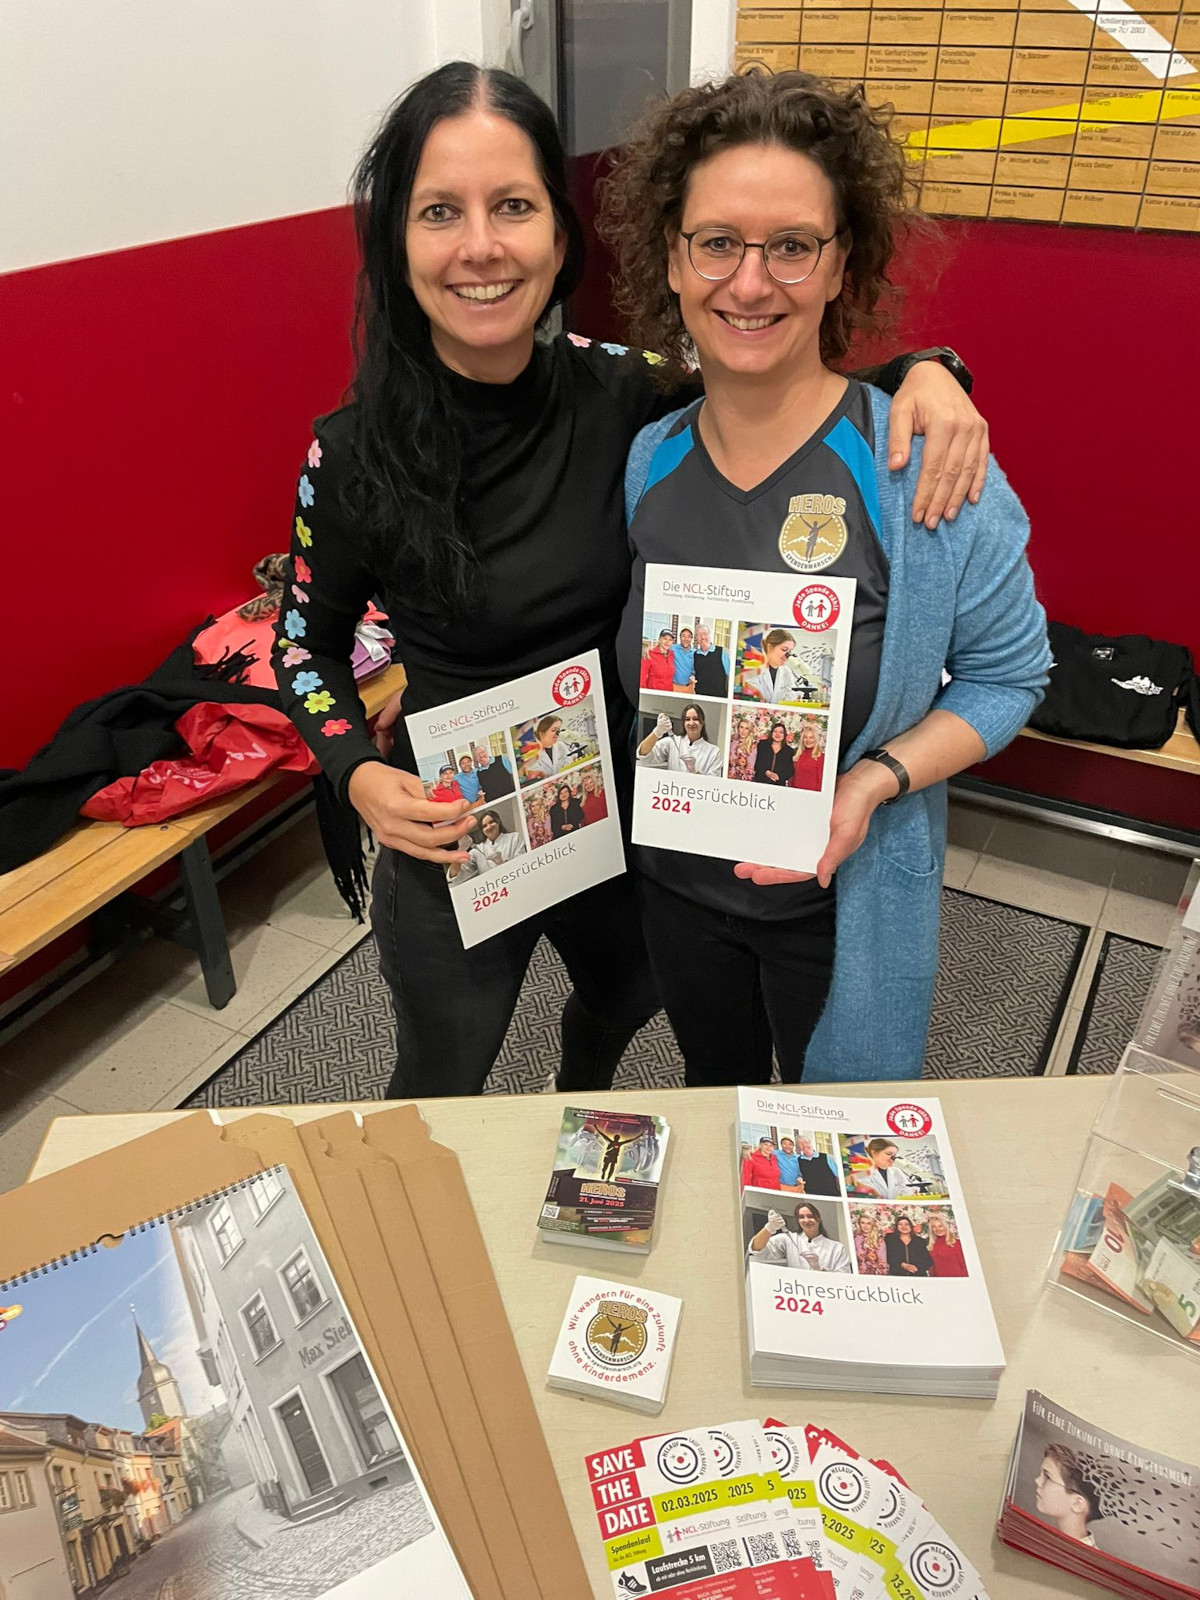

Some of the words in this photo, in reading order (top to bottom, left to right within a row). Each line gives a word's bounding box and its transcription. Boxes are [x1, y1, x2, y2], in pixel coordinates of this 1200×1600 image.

[788, 493, 846, 515] HEROS
[785, 553, 833, 569] SPENDENMARSCH
[663, 580, 680, 592] Die
[683, 582, 751, 600] NCL-Stiftung
[795, 592, 807, 608] Jede
[805, 587, 830, 596] Spende
[829, 592, 839, 611] zählt
[801, 621, 830, 631] DANKE!
[428, 723, 447, 735] Die
[449, 699, 515, 728] NCL-Stiftung
[651, 797, 692, 814] 2024
[652, 781, 776, 811] Jahresrückblick
[470, 842, 577, 900] Jahresrückblick
[472, 887, 509, 913] 2024
[756, 1099, 774, 1110] Die
[777, 1102, 844, 1118] NCL-Stiftung
[580, 1183, 627, 1198] HEROS
[1104, 1227, 1125, 1254] 10
[773, 1278, 924, 1305] Jahresrückblick
[597, 1300, 649, 1324] HEROS
[774, 1295, 824, 1316] 2024
[1178, 1293, 1197, 1318] 5
[568, 1314, 580, 1331] Wir
[577, 1291, 617, 1313] wandern
[619, 1290, 635, 1300] für
[636, 1296, 654, 1313] eine
[652, 1312, 666, 1353] Zukunft
[298, 1343, 325, 1369] Max
[568, 1340, 583, 1364] ohne
[582, 1361, 657, 1382] Kinderdemenz.
[592, 1345, 634, 1363] SPENDENMARSCH
[1032, 1400, 1046, 1420] FÜR
[1047, 1410, 1065, 1431] EINE
[1067, 1421, 1103, 1450] ZUKUNFT
[1104, 1439, 1126, 1460] OHNE
[662, 1441, 679, 1458] HELAUF
[591, 1448, 635, 1478] SAVE
[831, 1466, 854, 1474] HELAUF
[597, 1478, 633, 1505] THE
[661, 1488, 719, 1513] 02.03.2025
[604, 1502, 650, 1534] DATE
[682, 1517, 731, 1536] NCL-Stiftung
[611, 1534, 651, 1555] Spendenlauf
[930, 1546, 954, 1562] HELAUF
[651, 1557, 689, 1575] Laufstrecke
[689, 1555, 695, 1565] 5
[694, 1553, 707, 1563] km
